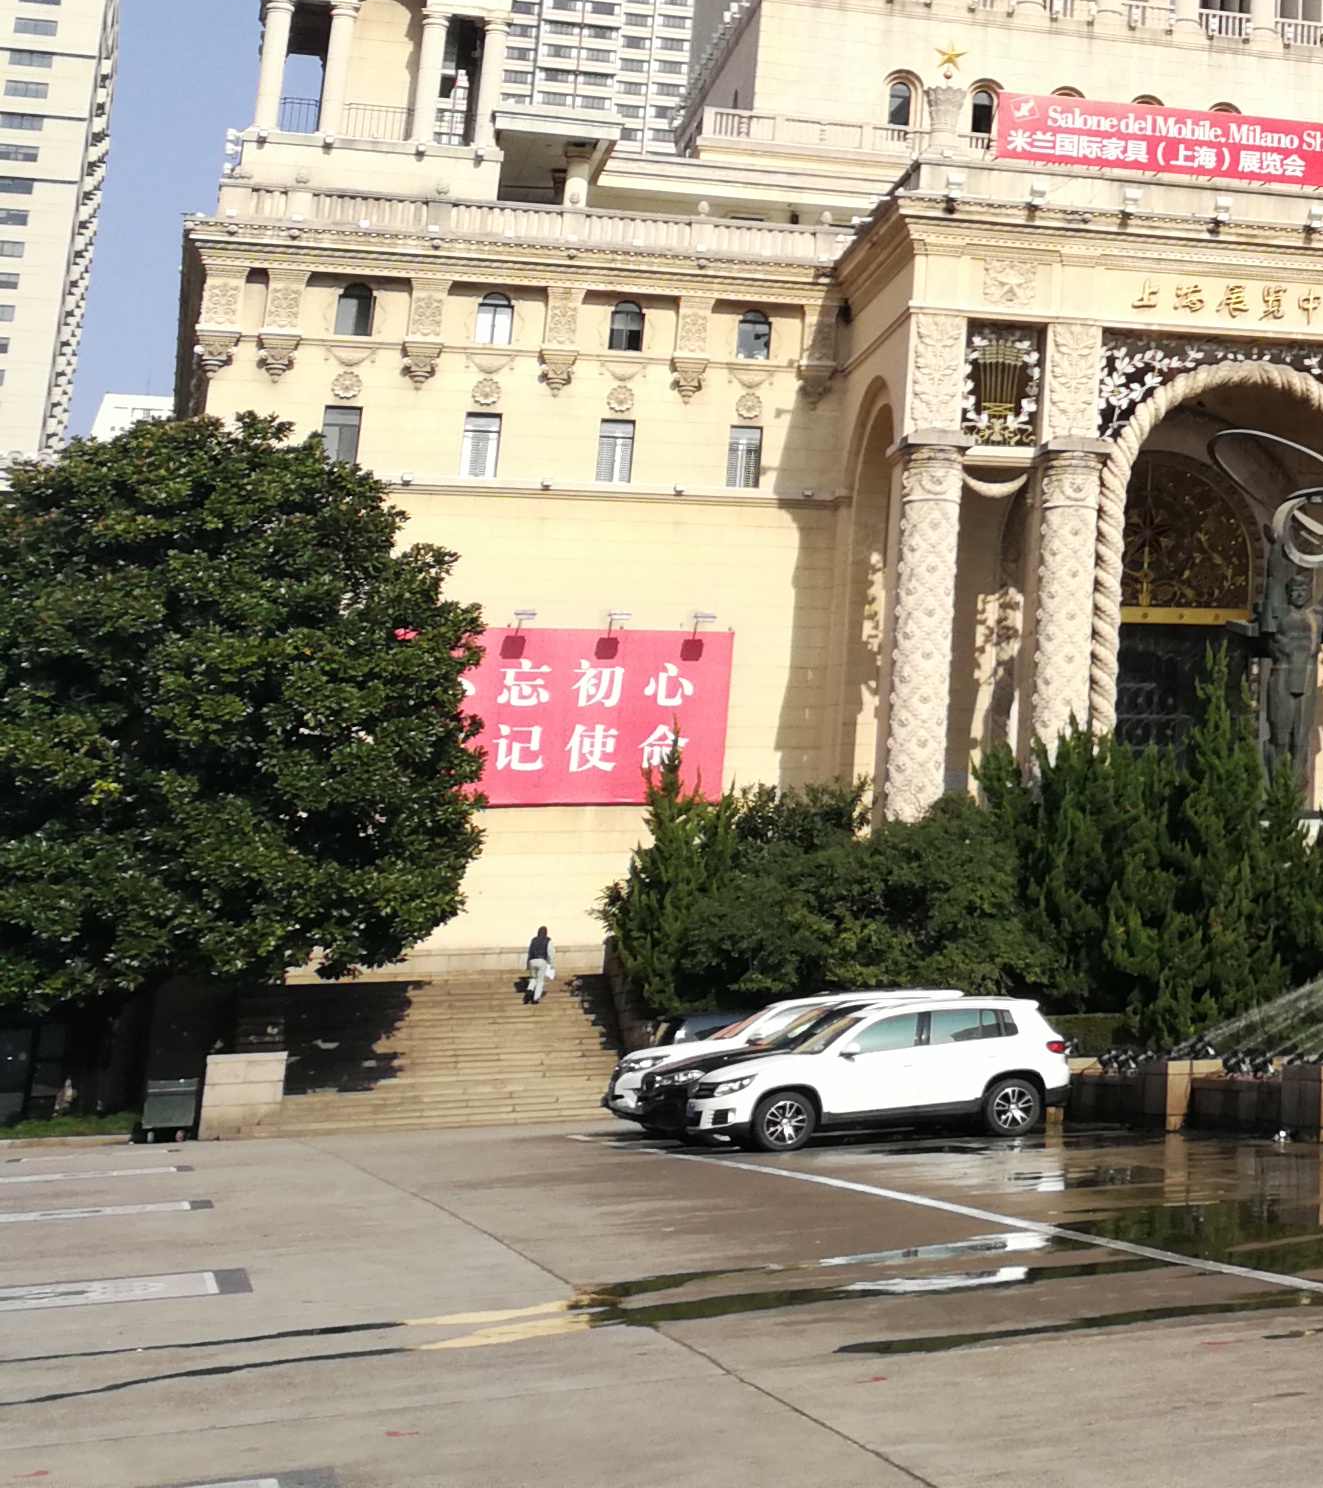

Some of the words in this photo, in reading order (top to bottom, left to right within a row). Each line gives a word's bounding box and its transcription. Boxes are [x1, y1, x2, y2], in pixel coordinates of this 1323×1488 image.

[1047, 105, 1118, 132] Salone
[1120, 113, 1153, 135] del
[1155, 116, 1226, 144] Mobile.
[1229, 122, 1299, 150] Milano
[1007, 128, 1306, 178] 米兰国际家具（上海）展览会
[457, 659, 694, 707] 忘初心
